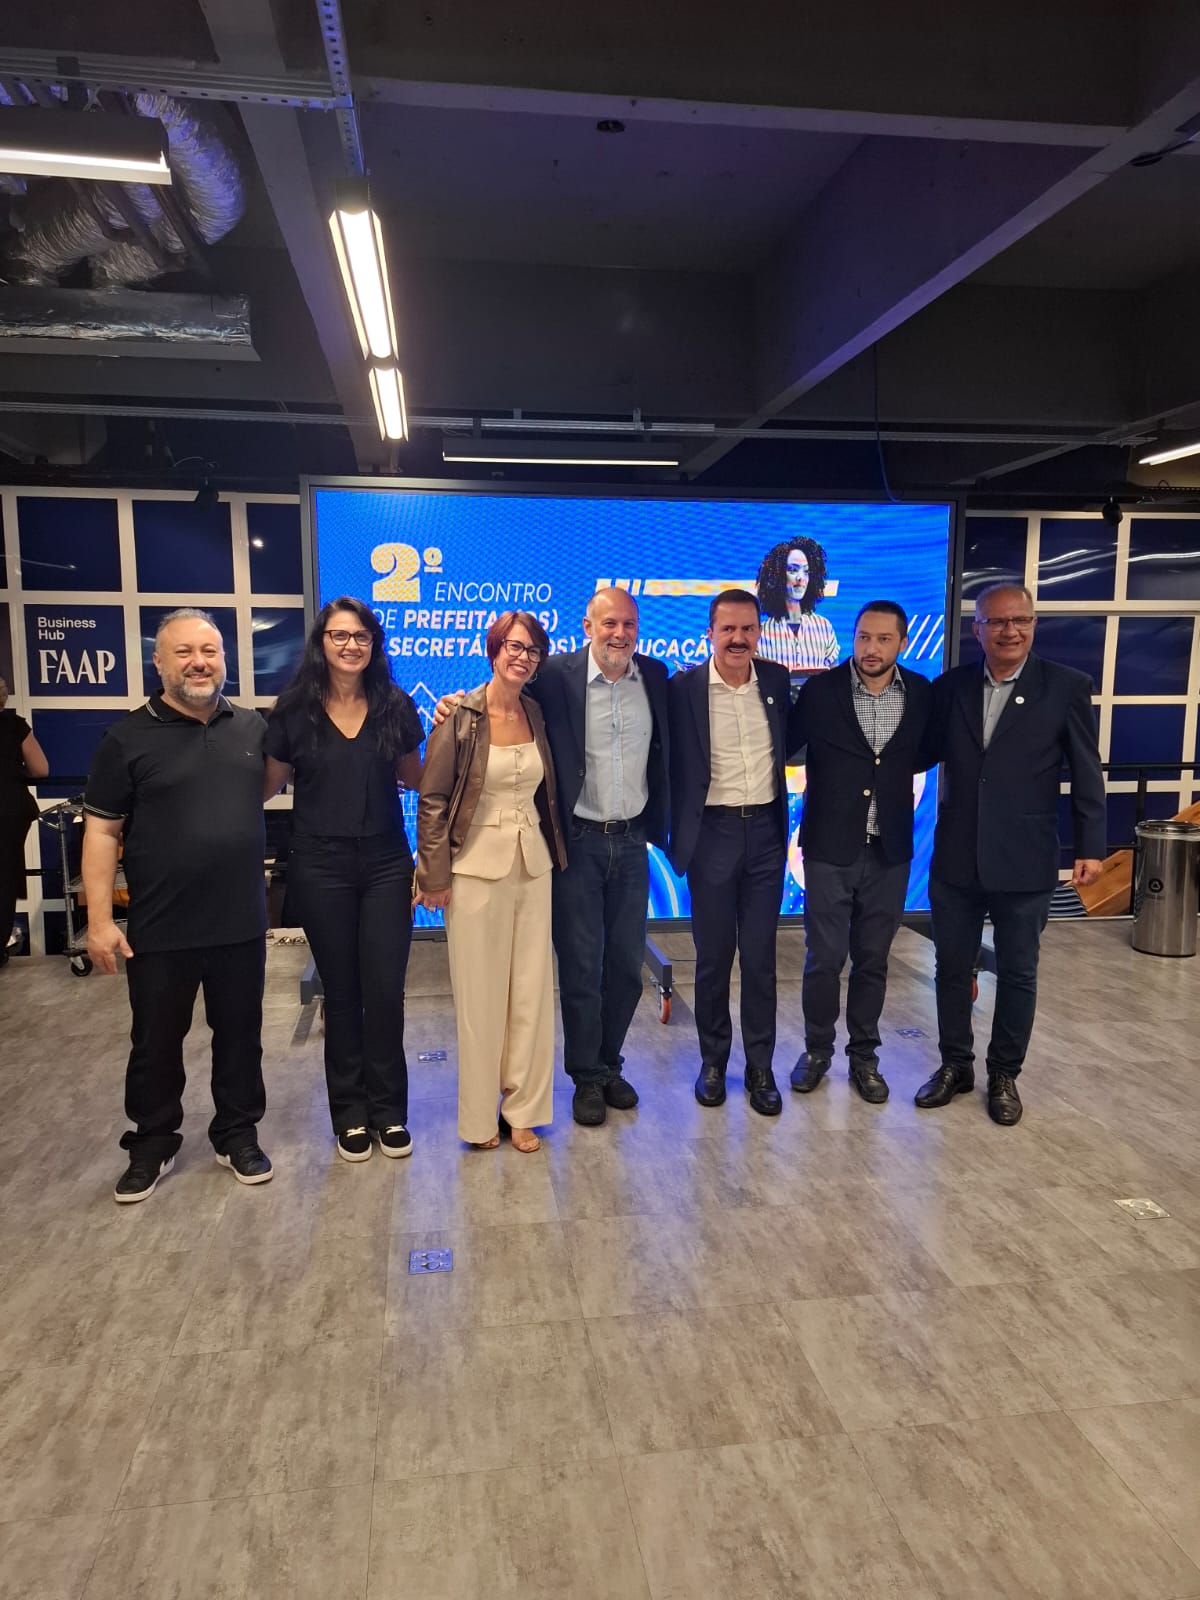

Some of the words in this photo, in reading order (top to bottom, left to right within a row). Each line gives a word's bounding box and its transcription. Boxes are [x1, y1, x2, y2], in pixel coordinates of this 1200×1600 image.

[434, 581, 552, 603] ENCONTRO
[37, 616, 97, 629] Business
[372, 608, 398, 629] DE
[38, 629, 66, 641] Hub
[38, 649, 116, 684] FAAP
